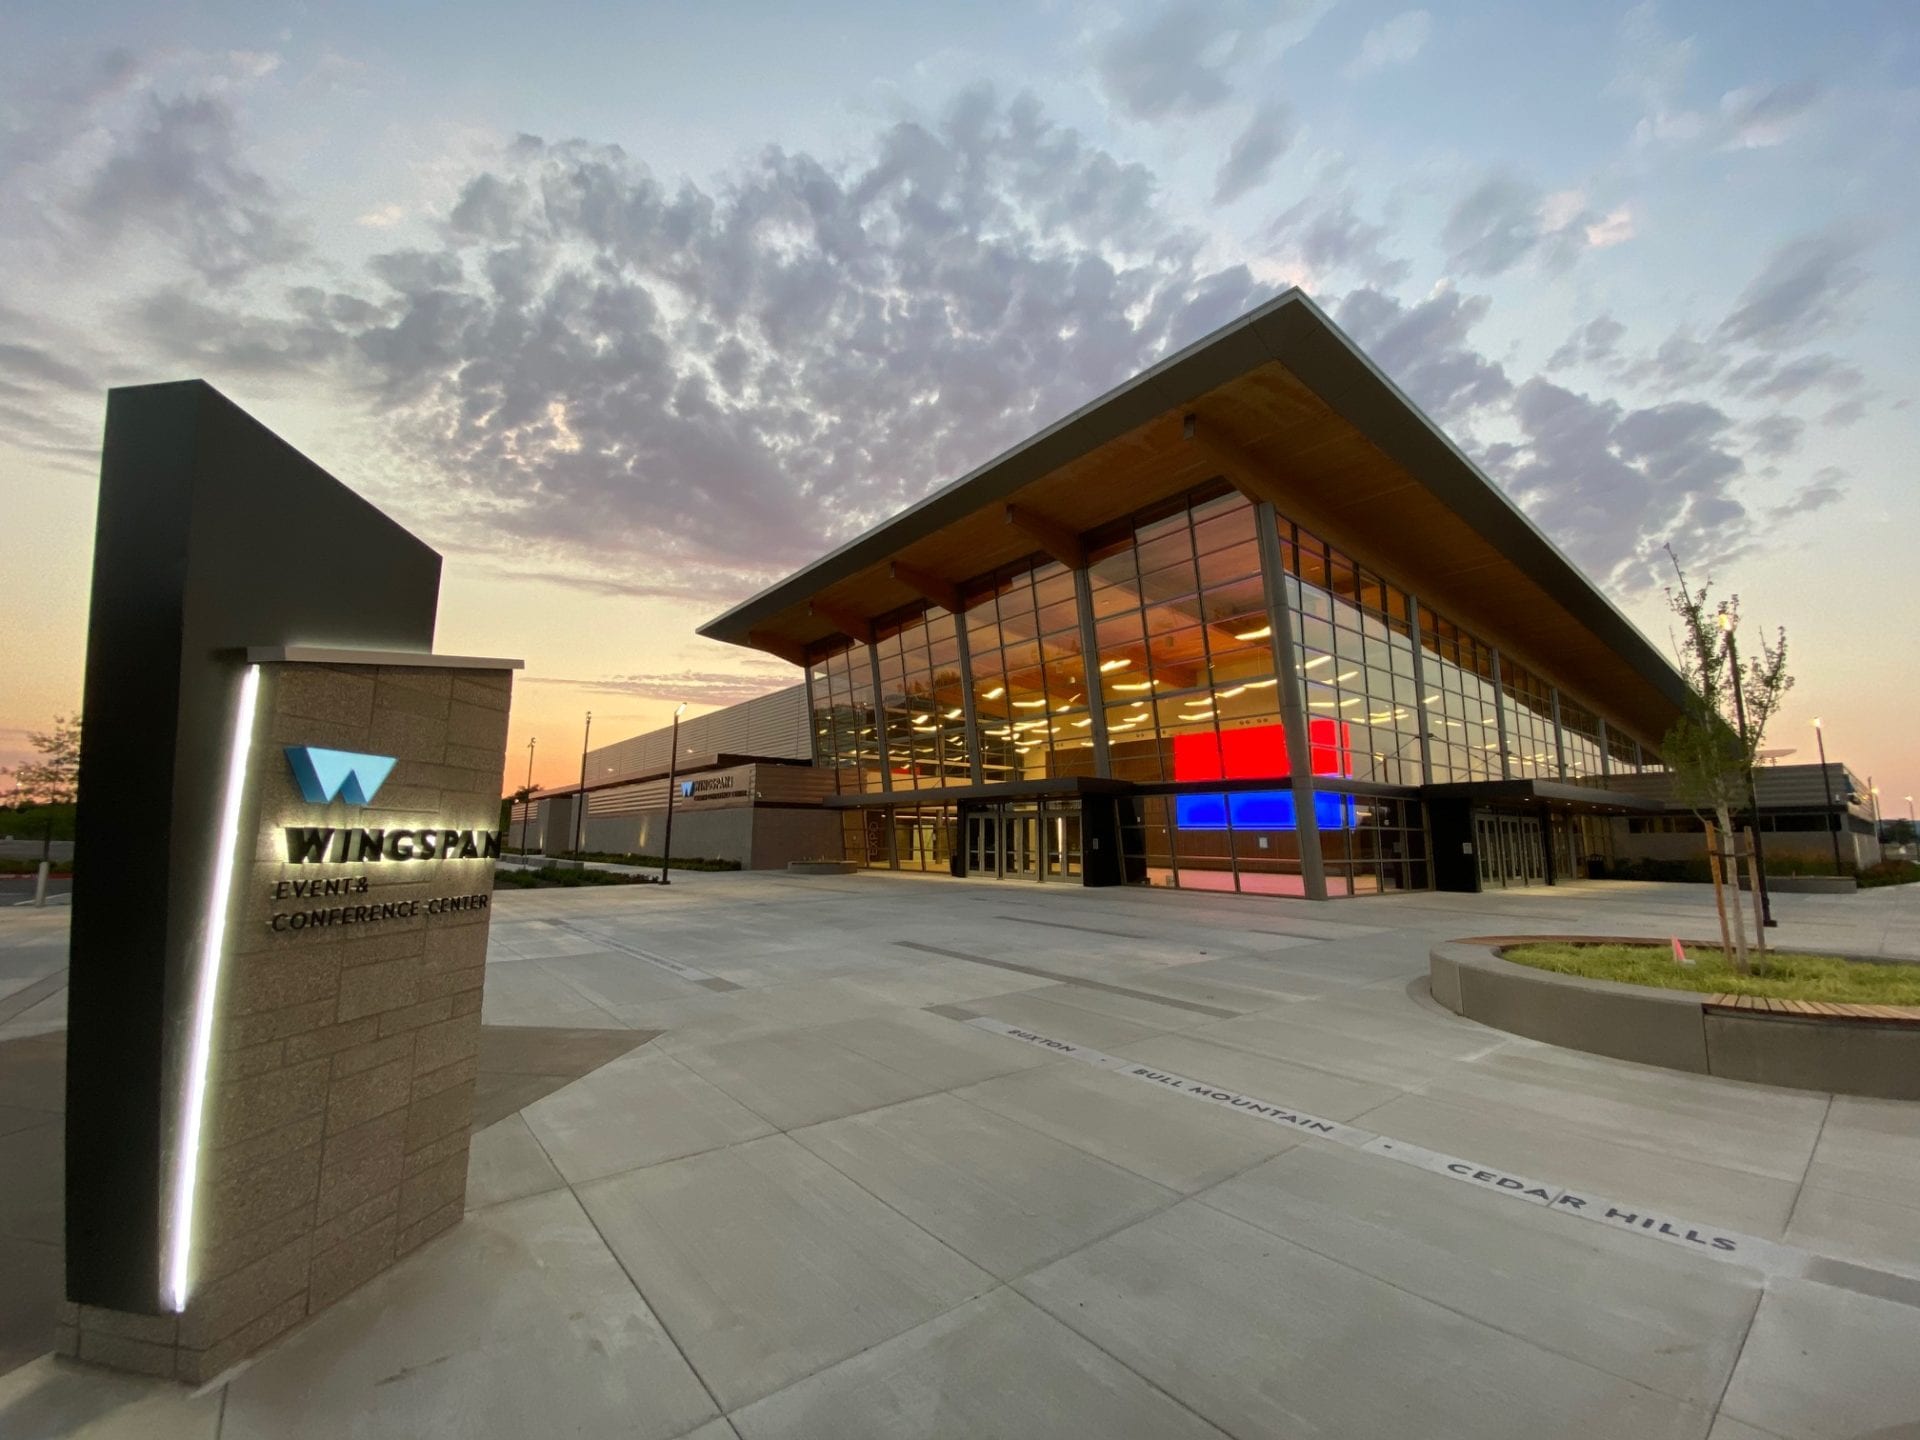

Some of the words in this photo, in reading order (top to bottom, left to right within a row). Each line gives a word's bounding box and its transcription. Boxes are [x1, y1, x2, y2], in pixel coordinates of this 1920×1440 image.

[284, 827, 500, 864] WINGSPAN
[271, 877, 354, 900] EVENT
[270, 901, 420, 932] CONFERENCE
[427, 894, 488, 915] CENTER
[1007, 1028, 1077, 1053] BUXTON
[1132, 1068, 1183, 1088] BULL
[1188, 1086, 1335, 1134] MOUNTAIN
[1447, 1163, 1587, 1210] CEDAR
[1604, 1207, 1737, 1252] HILLS
